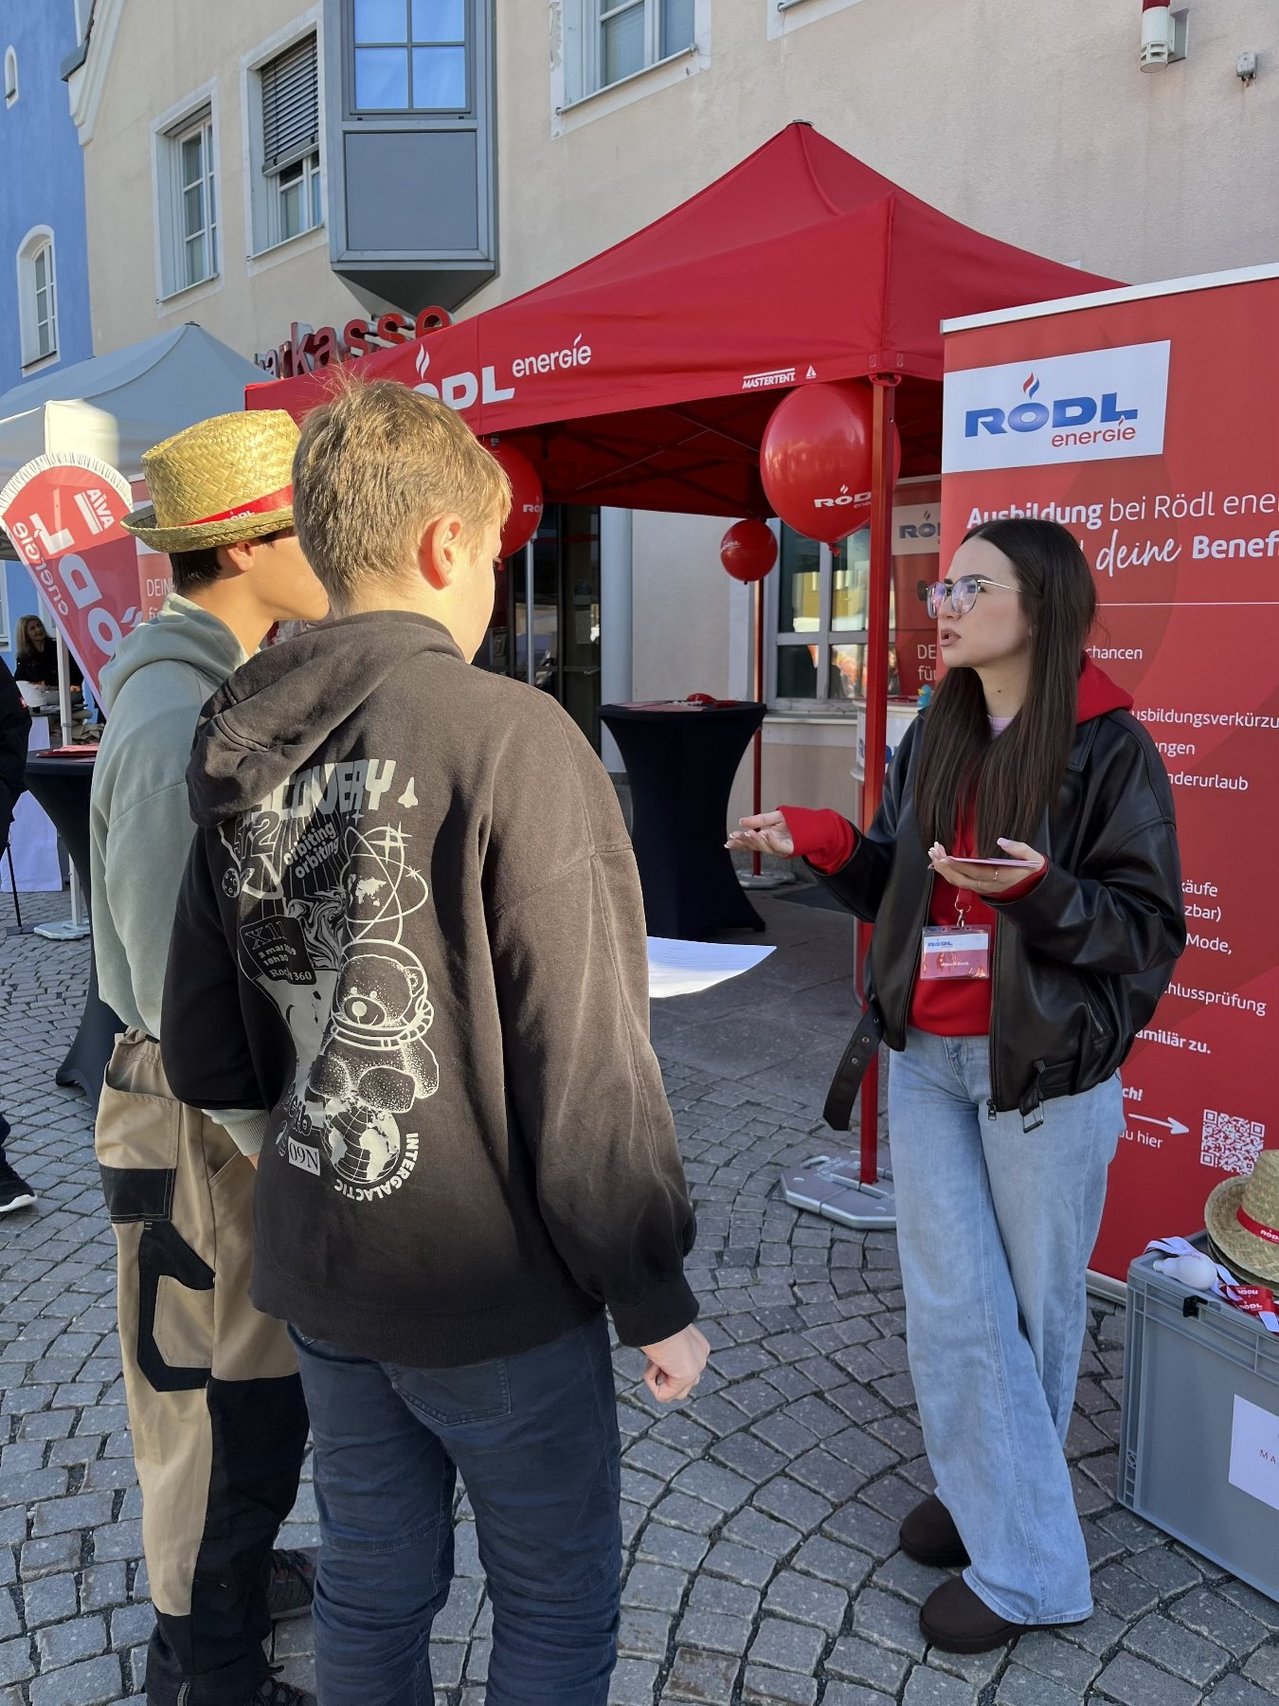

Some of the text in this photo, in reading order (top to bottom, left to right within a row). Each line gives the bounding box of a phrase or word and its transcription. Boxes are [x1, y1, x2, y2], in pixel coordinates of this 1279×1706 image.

[255, 305, 452, 378] arkasse
[1109, 496, 1146, 521] bei
[1154, 491, 1215, 519] Rödl
[1223, 493, 1279, 515] ene
[1095, 529, 1279, 578] deine Benef
[1155, 742, 1195, 758] ngen
[283, 821, 337, 866] orbiting
[1185, 933, 1232, 955] Mode,
[1164, 981, 1267, 1017] hlussprüfung
[1188, 1040, 1211, 1054] zu.
[1137, 1130, 1163, 1148] hier
[334, 1132, 420, 1202] INTERGALACTIC
